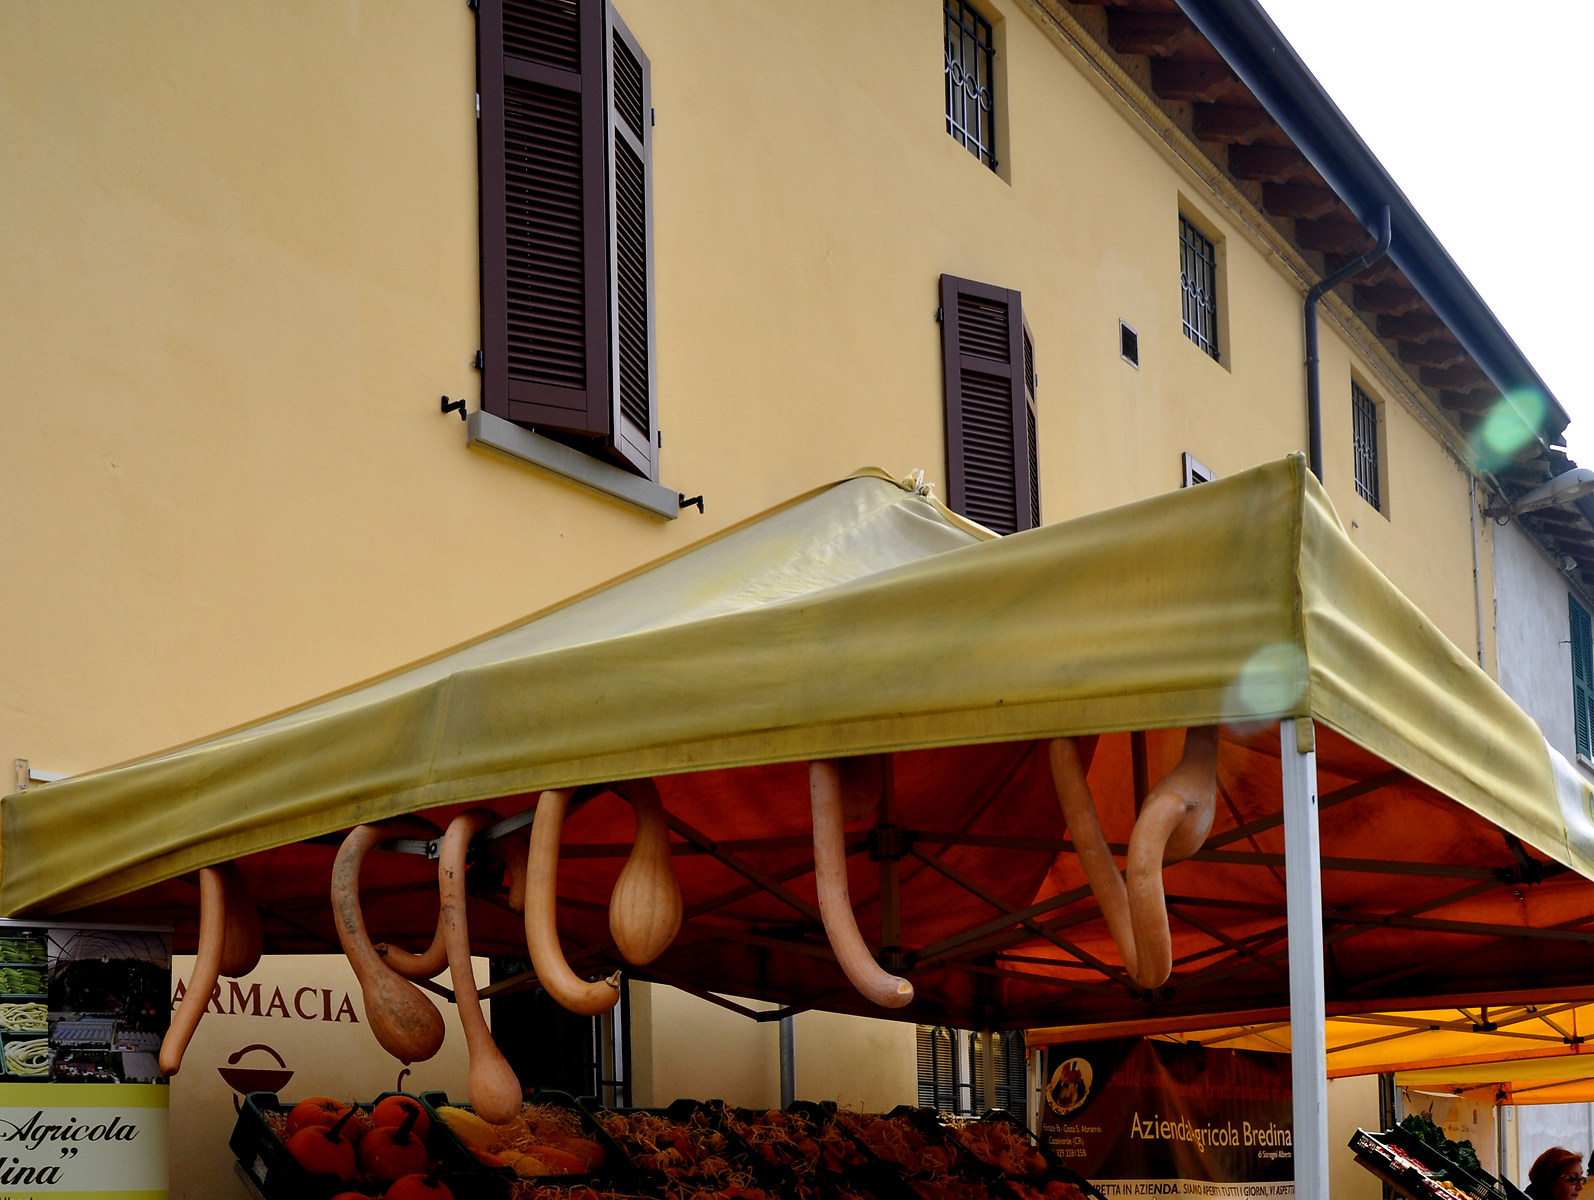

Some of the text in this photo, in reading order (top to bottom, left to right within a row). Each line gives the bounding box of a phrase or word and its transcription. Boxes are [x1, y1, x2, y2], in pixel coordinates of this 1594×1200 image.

[0, 1110, 140, 1151] Agricola
[1081, 1125, 1102, 1133] Abramo
[1242, 1121, 1292, 1147] Bredina
[1123, 1184, 1132, 1195] IN
[1134, 1183, 1181, 1195] AZIENDA.
[1183, 1183, 1202, 1195] SIAMO
[1203, 1185, 1221, 1196] APERTI
[1221, 1186, 1239, 1196] TUTTI
[1243, 1186, 1268, 1198] GIORNI,
